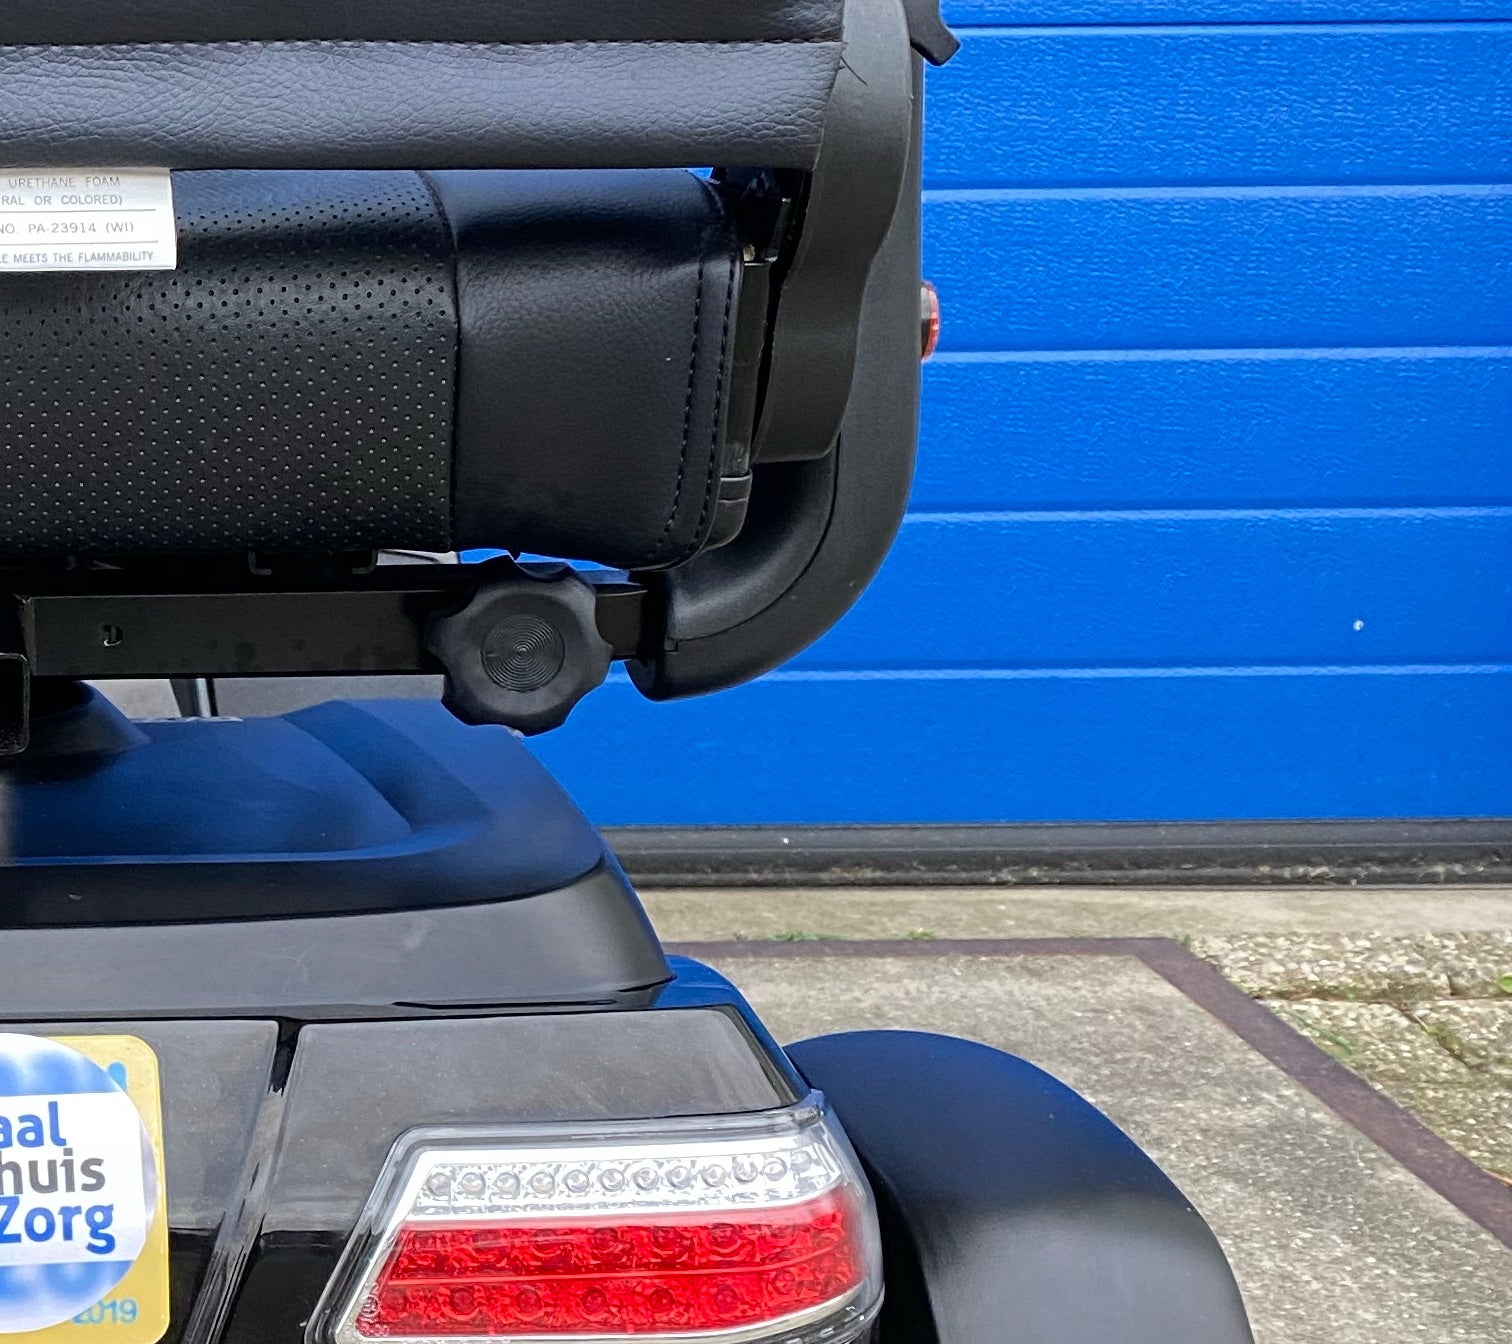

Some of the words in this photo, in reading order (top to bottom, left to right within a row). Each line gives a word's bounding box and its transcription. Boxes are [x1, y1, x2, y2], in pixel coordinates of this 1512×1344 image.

[9, 177, 76, 189] URETHANE
[86, 176, 121, 187] FOAM
[34, 195, 51, 205] OR
[61, 194, 123, 206] COLORED)
[28, 222, 97, 233] PA-23914
[13, 253, 47, 263] MEETS
[53, 253, 73, 262] THE
[79, 251, 154, 262] FLAMMABILITY
